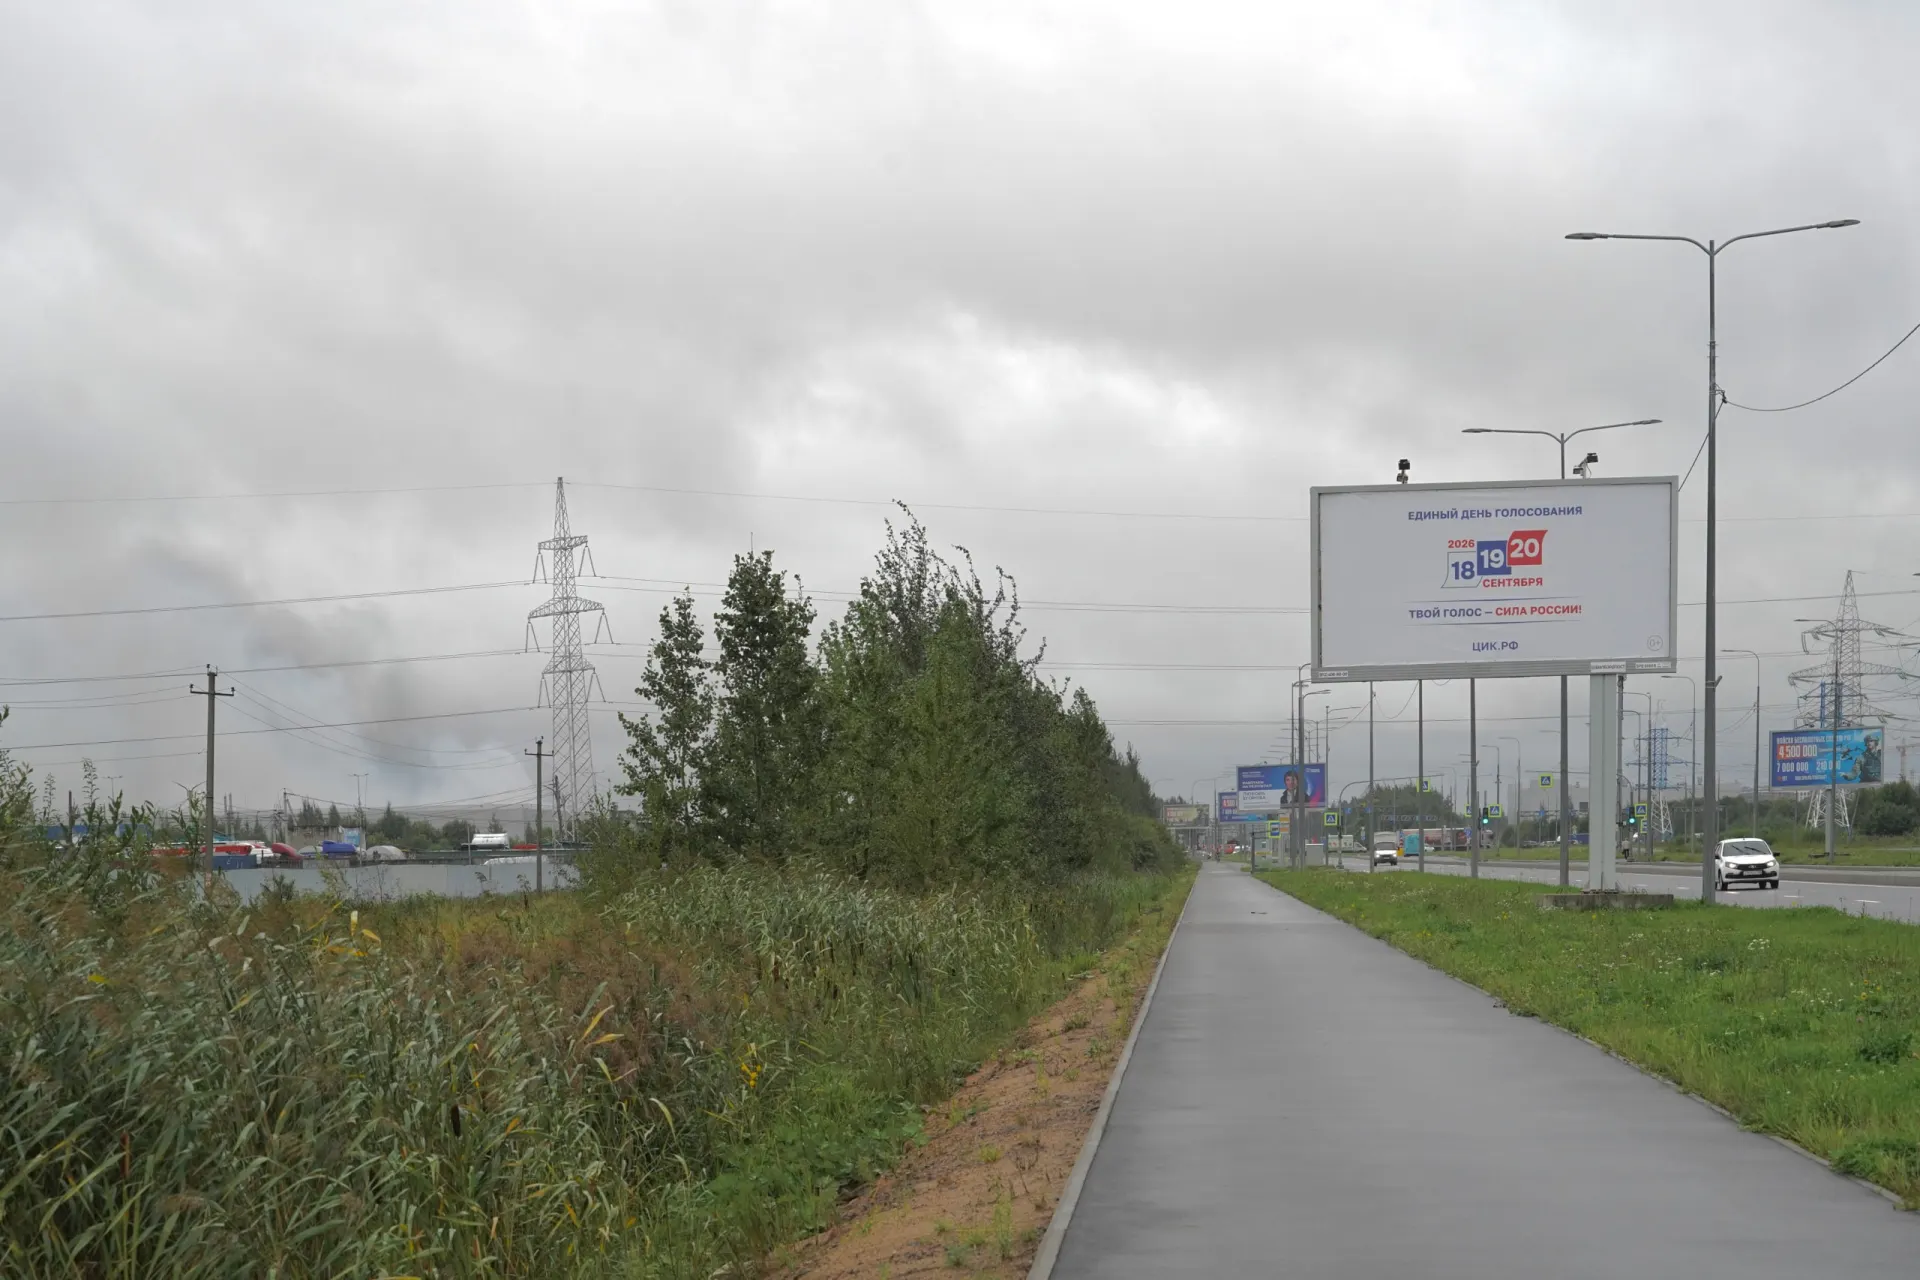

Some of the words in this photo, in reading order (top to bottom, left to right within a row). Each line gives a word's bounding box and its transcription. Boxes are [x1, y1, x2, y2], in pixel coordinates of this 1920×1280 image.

[1408, 508, 1458, 521] ЕДИНЫЙ
[1461, 509, 1492, 520] ДЕНЬ
[1495, 506, 1582, 518] ГОЛОСОВАНИЯ
[1448, 539, 1475, 549] 2026
[1451, 560, 1475, 580] 18
[1480, 548, 1504, 568] 19
[1510, 538, 1540, 558] 20
[1482, 577, 1543, 588] СЕНТЯБРЯ
[1409, 607, 1440, 619] ТВОЙ
[1443, 607, 1482, 618] ГОЛОС
[1495, 606, 1527, 617] СИЛА
[1530, 604, 1582, 616] РОССИИ!
[1472, 641, 1519, 653] ЦИК.РФ
[1779, 745, 1784, 758] 4
[1786, 745, 1801, 758] 500
[1802, 744, 1817, 757] 000
[1781, 762, 1795, 772] 000
[1796, 761, 1809, 772] 000
[1829, 760, 1841, 770] 00
